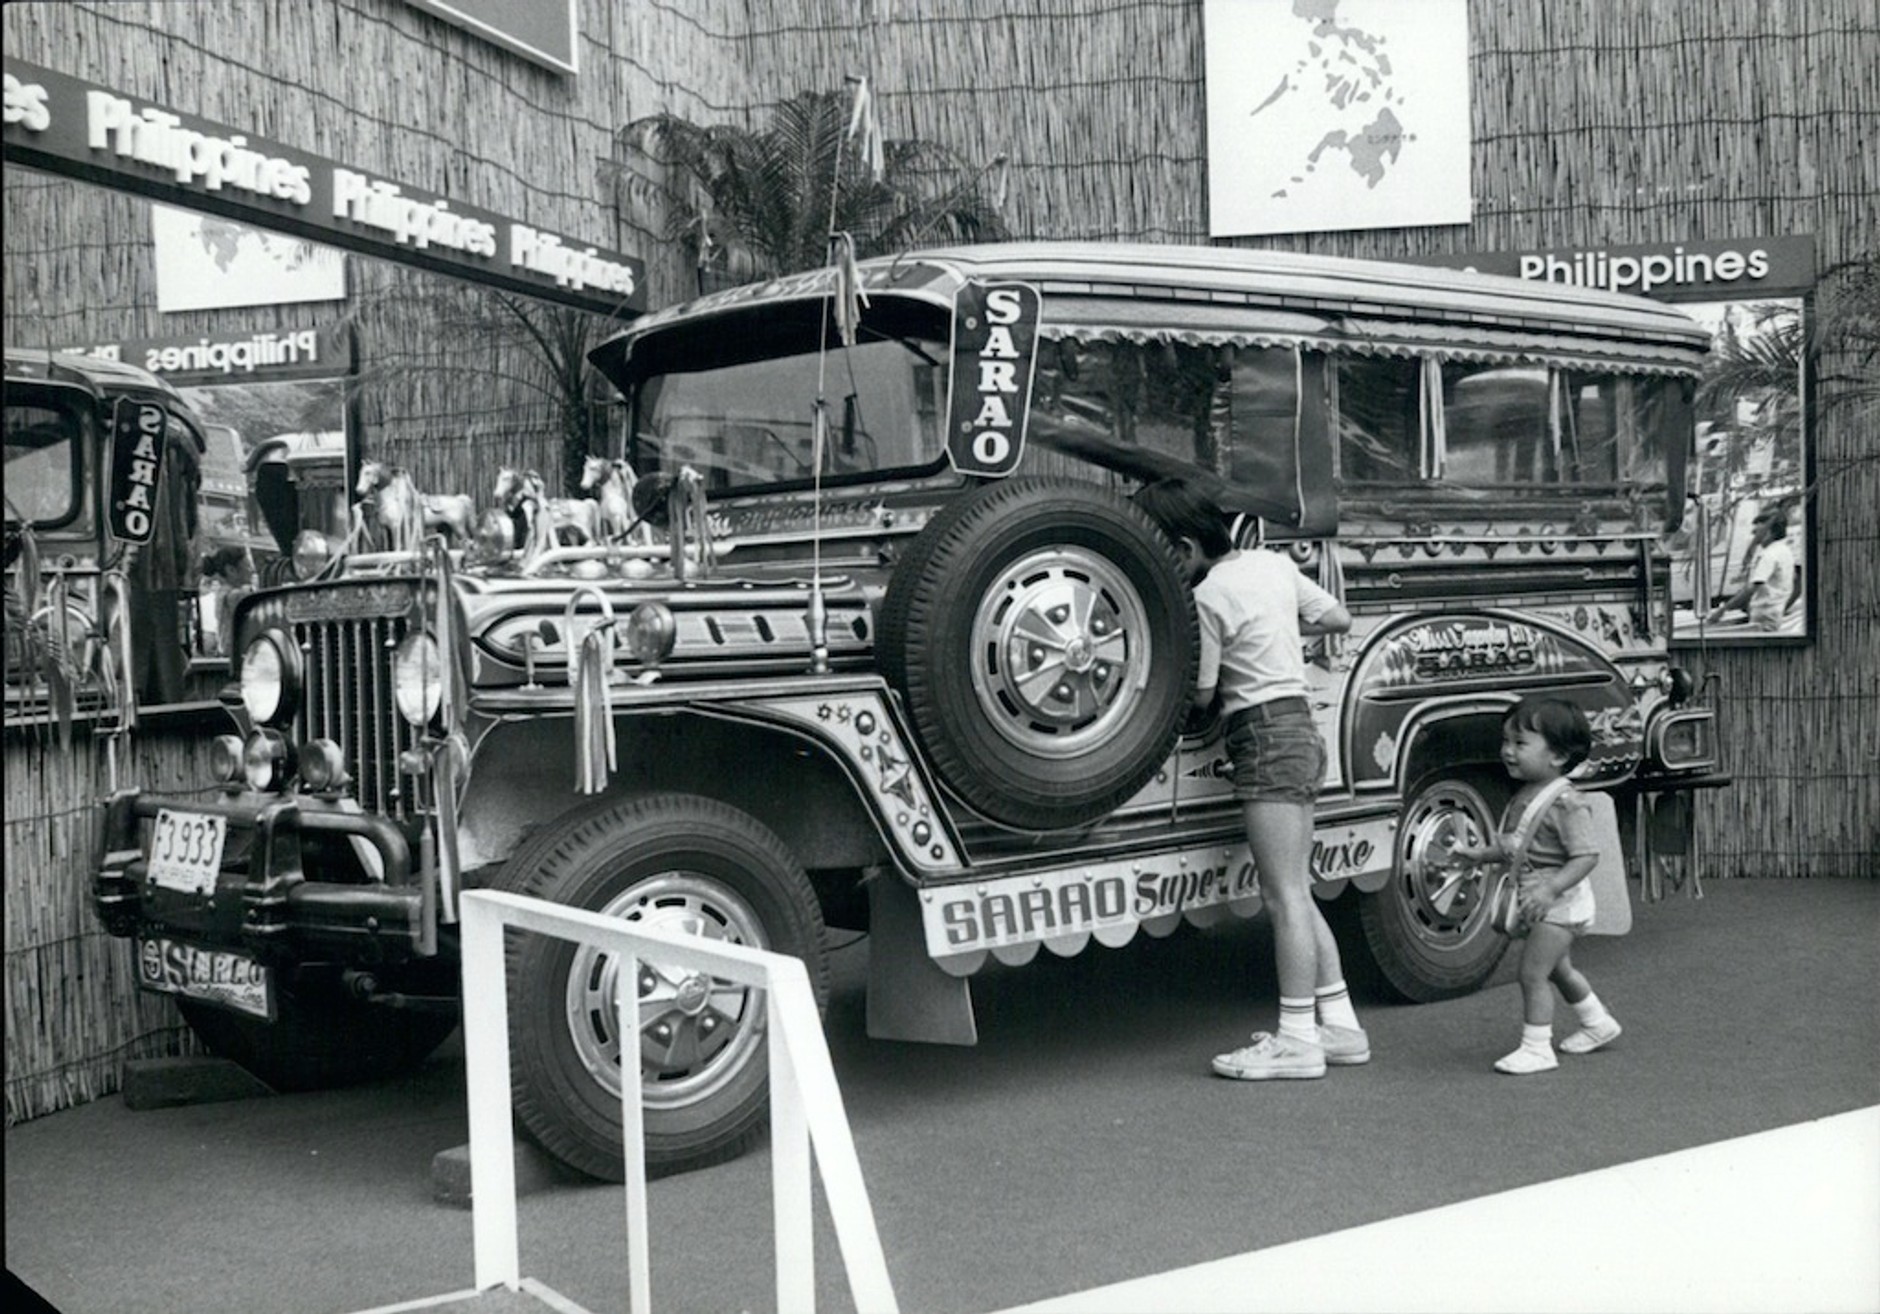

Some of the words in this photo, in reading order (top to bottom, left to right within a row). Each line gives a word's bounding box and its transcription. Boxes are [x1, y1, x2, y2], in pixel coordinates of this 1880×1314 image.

[87, 90, 311, 205] Philippines
[333, 168, 496, 257] Philippines
[510, 223, 634, 297] Philippines
[1520, 246, 1769, 292] Philippines
[972, 290, 1022, 464] SARAO
[943, 877, 1127, 945] SARAO
[1134, 864, 1228, 914] Super
